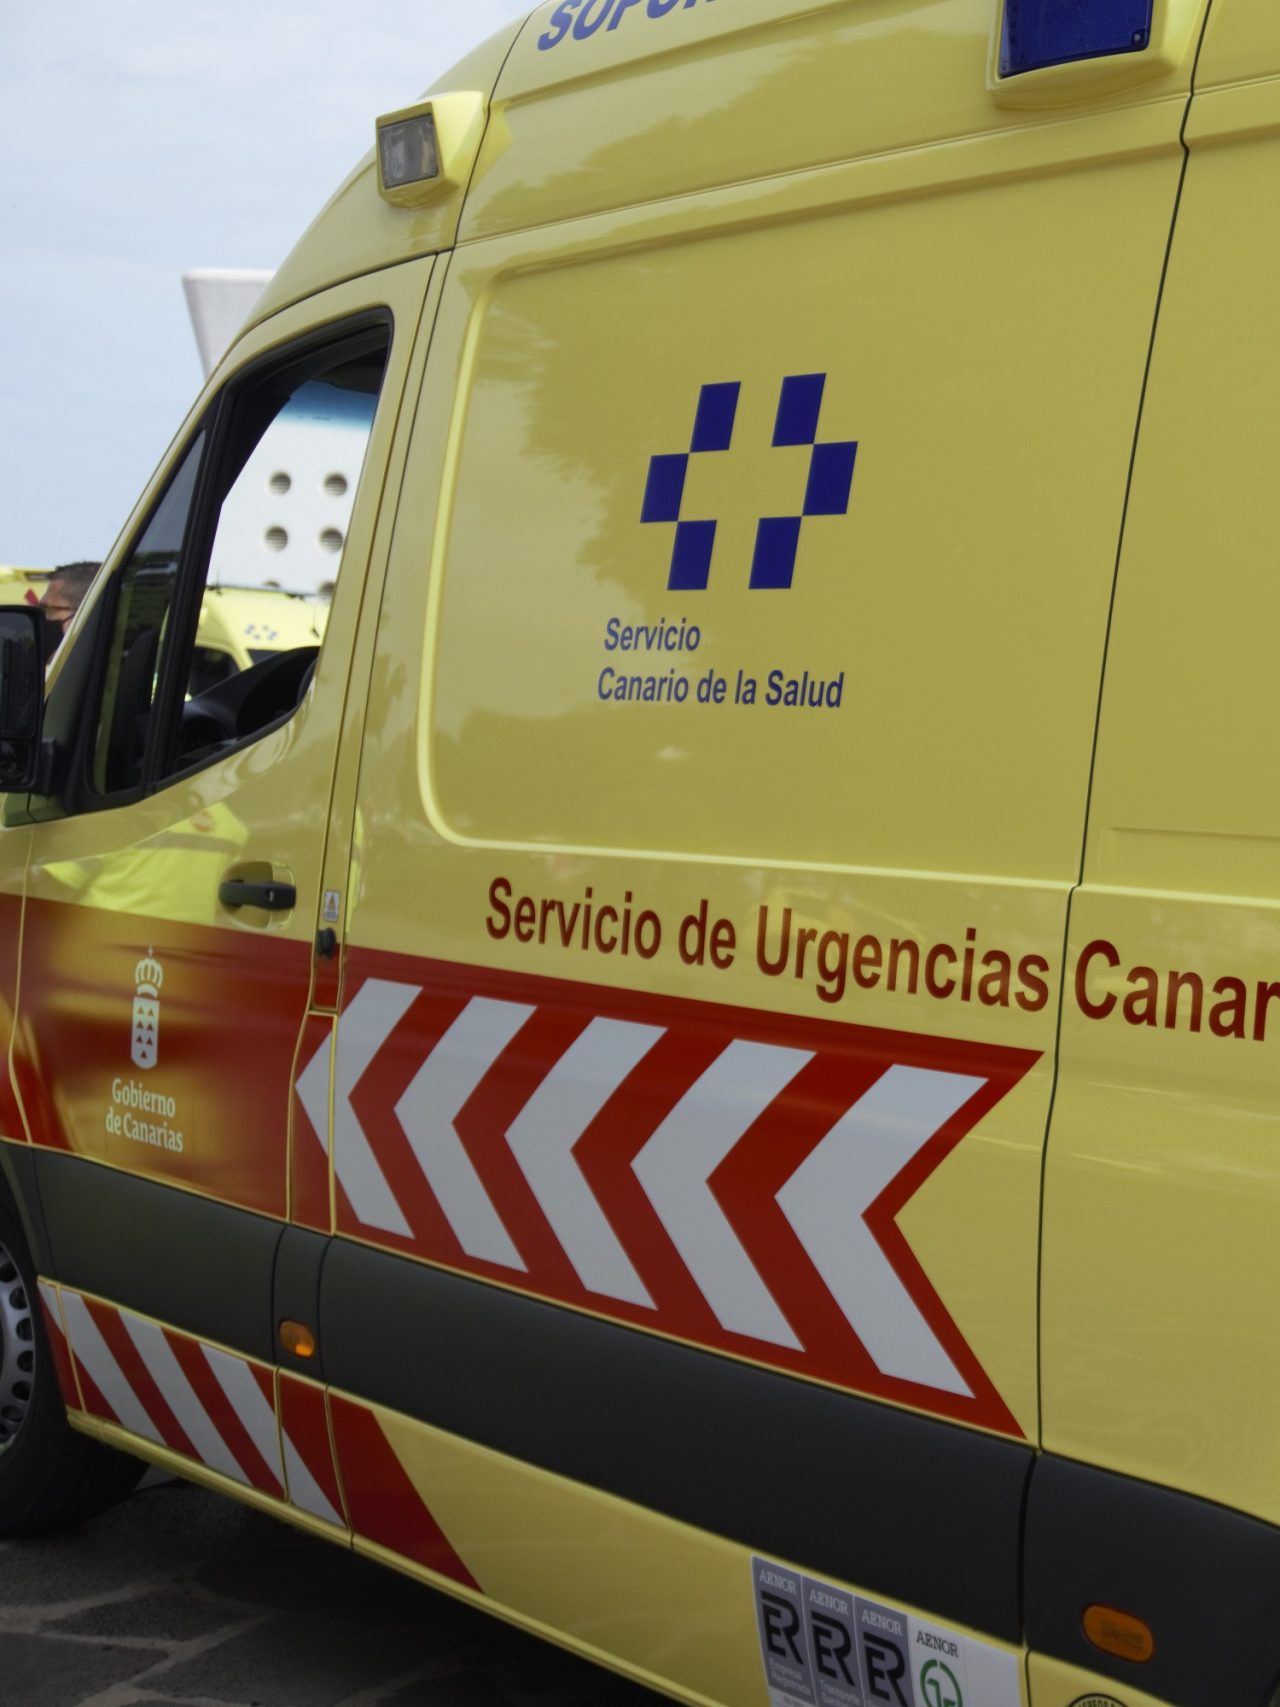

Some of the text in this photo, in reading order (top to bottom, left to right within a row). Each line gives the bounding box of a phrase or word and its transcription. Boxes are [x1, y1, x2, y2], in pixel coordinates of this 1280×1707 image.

[604, 617, 700, 651] Servicio
[598, 667, 844, 708] Canario de la Salud
[486, 877, 661, 961] Servicio
[679, 899, 737, 970] de
[756, 905, 1051, 1012] Urgencias
[112, 1078, 175, 1118] Gobierno
[106, 1107, 183, 1152] de Canarias
[759, 1568, 797, 1595] AENOR
[809, 1589, 849, 1617] AENOR
[861, 1609, 903, 1637] AENOR
[916, 1631, 960, 1659] AENOR
